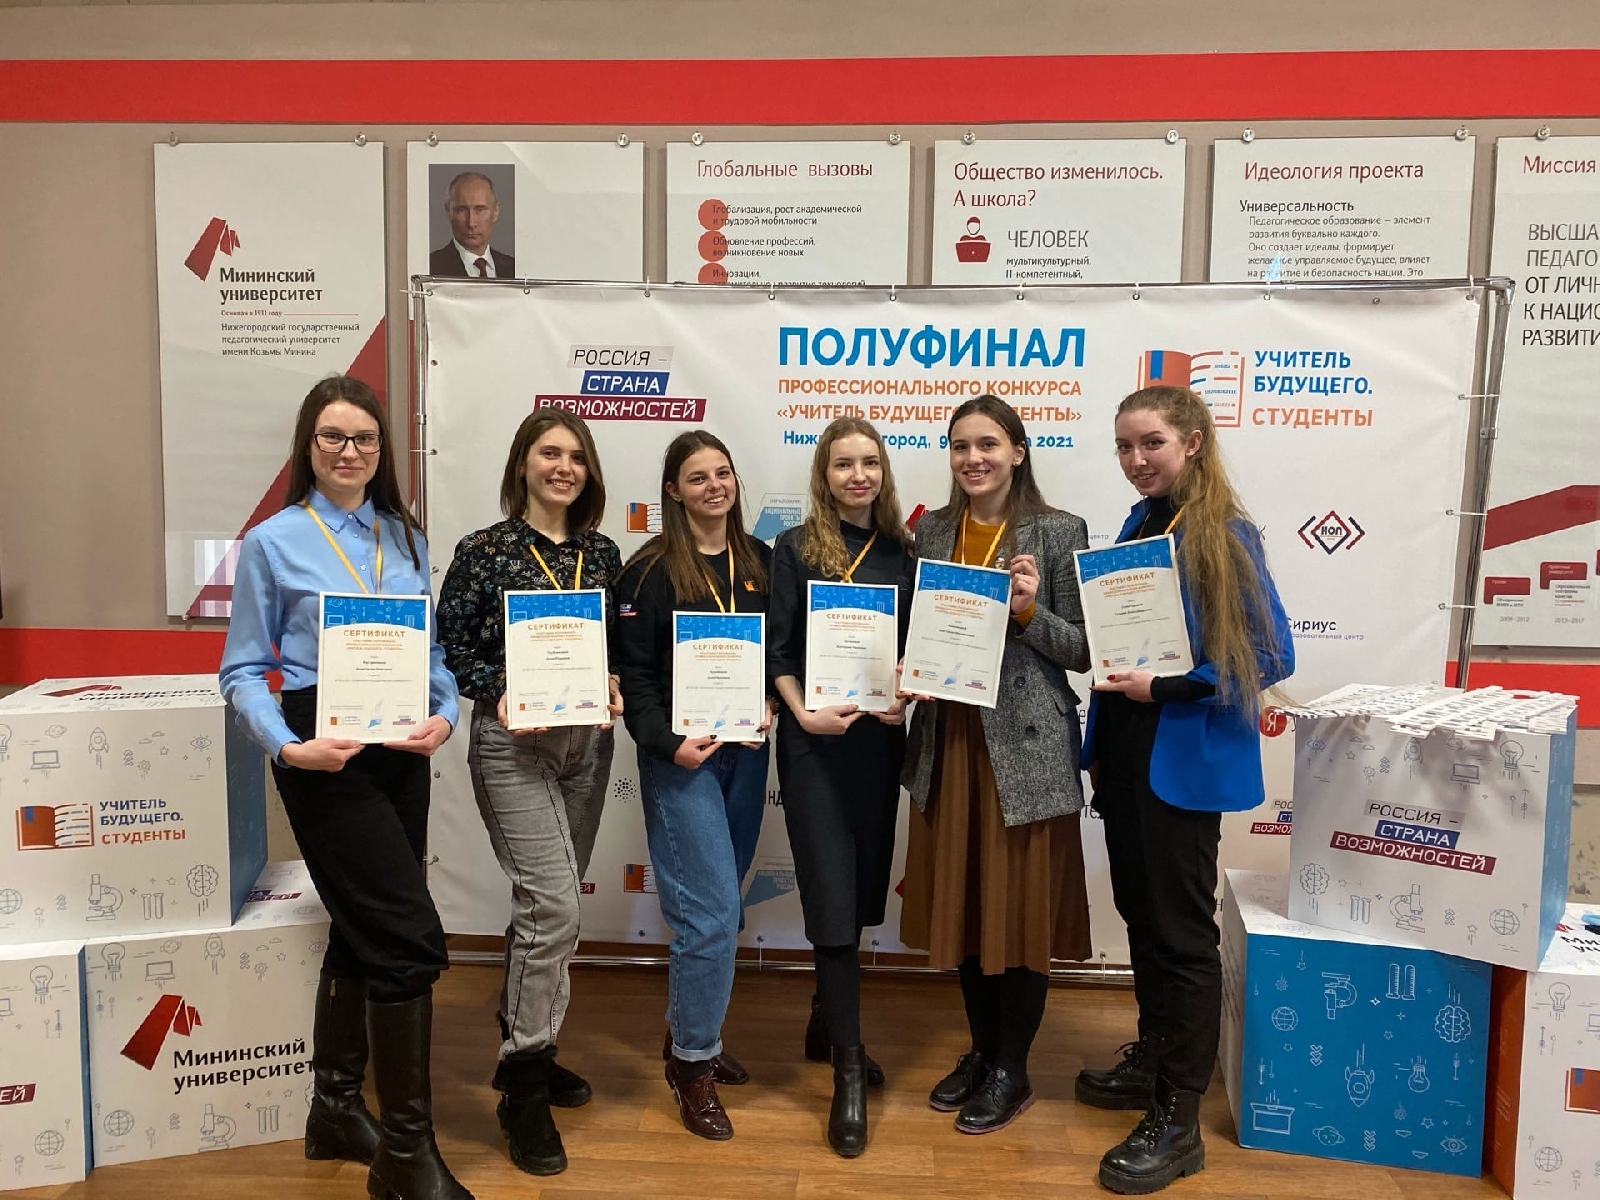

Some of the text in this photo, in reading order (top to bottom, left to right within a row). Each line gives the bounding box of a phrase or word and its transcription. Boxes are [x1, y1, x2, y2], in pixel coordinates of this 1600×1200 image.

[697, 160, 873, 177] Глобальные вызовы
[954, 162, 1163, 182] Общество изменилось.
[1245, 162, 1423, 183] Идеология проекта
[1523, 155, 1596, 174] Миссия
[953, 190, 1036, 207] А школа?
[713, 205, 862, 216] Глобализация, рост академической
[1239, 199, 1354, 215] Универсальность
[720, 216, 759, 227] трудовой
[761, 216, 818, 225] мобильности
[1249, 216, 1320, 226] Педагогическое
[1323, 215, 1381, 227] образование
[713, 237, 764, 247] Обновление
[1008, 230, 1089, 248] ЧЕЛОВЕК
[1248, 229, 1380, 240] развития буквально каждого.
[713, 249, 804, 257] возникновение новых
[1248, 242, 1266, 251] Оно
[1268, 244, 1303, 252] создает
[1343, 242, 1395, 253] формирует
[1247, 255, 1431, 266] желаеое управляемое будущее, влияет
[219, 267, 316, 283] Мининский
[1311, 268, 1372, 277] безопасность
[1407, 267, 1424, 277] Это
[1525, 276, 1550, 293] ОТ
[219, 289, 323, 305] университет
[1523, 303, 1536, 320] К
[221, 323, 360, 334] Нижегородский государственный
[222, 336, 341, 346] педагогический университет
[779, 324, 1086, 368] ПОЛУФИНАЛ
[222, 347, 316, 356] имени Козьмы Минина
[574, 349, 650, 366] РОССИЯ
[1254, 350, 1351, 369] УЧИТЕЛЬ
[586, 375, 661, 394] СТРАНА
[778, 378, 1082, 396] ПРОФЕССИОНАЛЬНОГО КОНКУРСА
[1254, 376, 1373, 396] БУДУЩЕГО.
[776, 404, 866, 420] «УЧИТЕЛЬ
[1252, 407, 1373, 429] СТУДЕНТЫ
[1036, 436, 1074, 448] 2021
[1099, 571, 1155, 587] СЕРТИФИКАТ
[934, 594, 989, 608] СЕРТИФИКАТ
[826, 613, 878, 621] СЕРТИФИКАТ
[343, 629, 406, 637] СЕРТИФИКАТ
[527, 622, 585, 631] СЕРТИФИКАТ
[99, 798, 167, 811] УЧИТЕЛЬ
[100, 811, 184, 826] БУДУЩЕГО.
[1369, 803, 1442, 825] РОССИЯ
[101, 829, 186, 845] СТУДЕНТЫ
[1380, 824, 1451, 847] СТРАНА
[1335, 834, 1486, 871] ВОЗМОЖНОСТЕЙ
[173, 1038, 306, 1069] Мининский
[173, 1060, 314, 1095] университет
